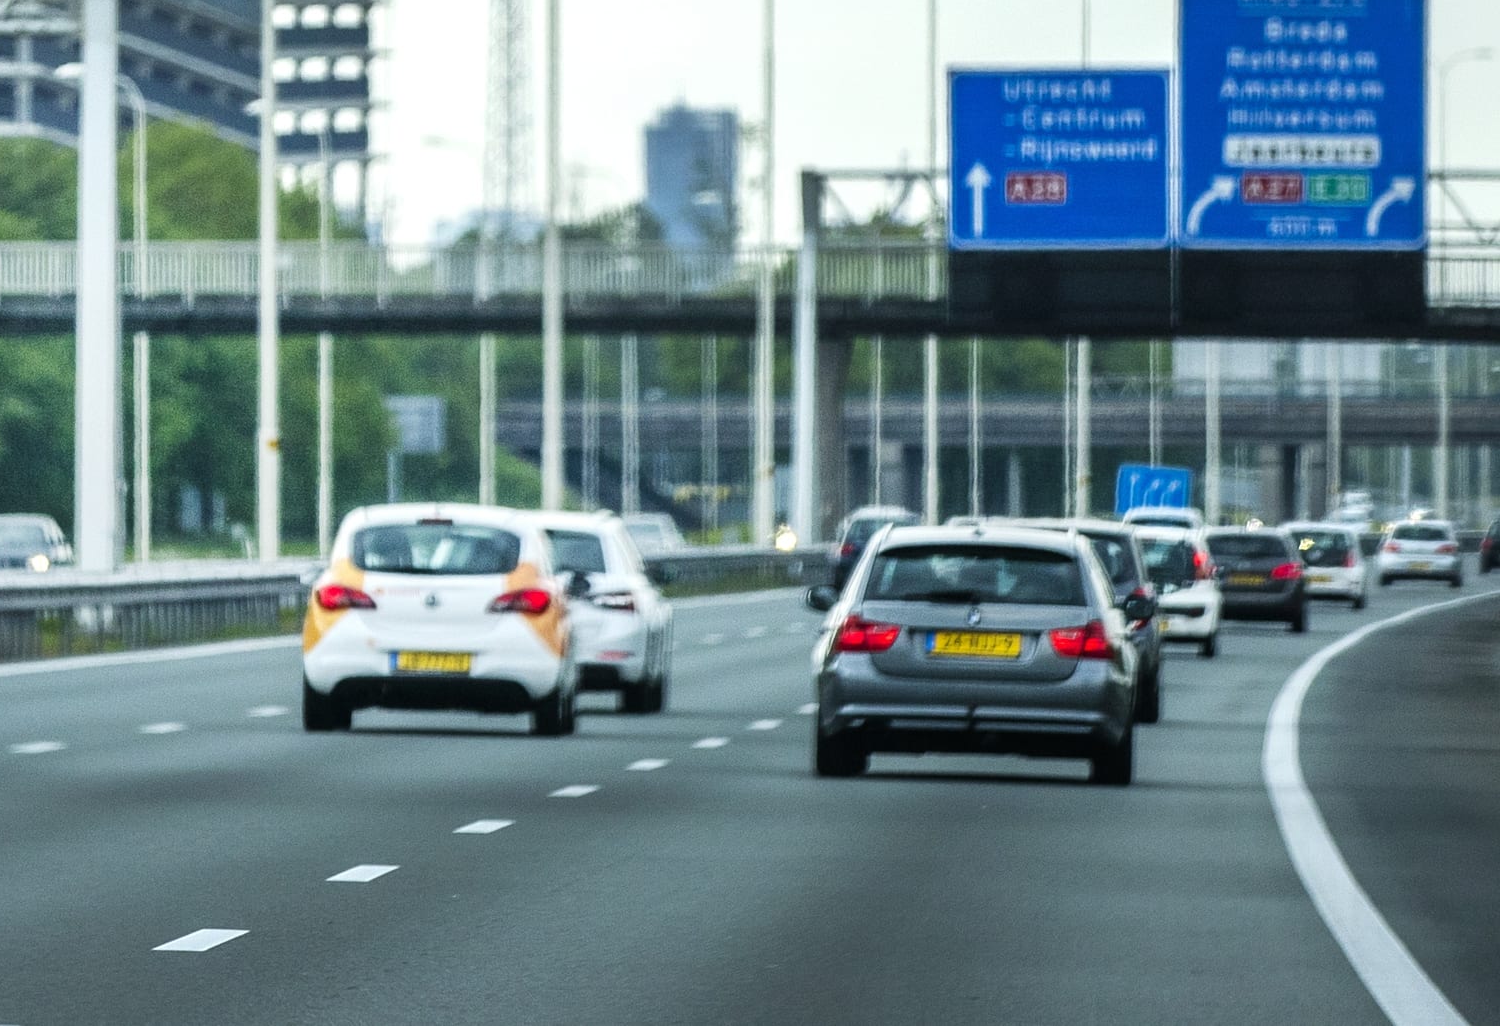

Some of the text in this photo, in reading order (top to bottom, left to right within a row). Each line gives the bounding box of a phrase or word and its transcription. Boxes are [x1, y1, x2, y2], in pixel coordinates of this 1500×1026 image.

[1227, 47, 1377, 71] Rotterdam
[1005, 78, 1111, 102] Utrecht
[1220, 77, 1384, 101] Amsterdam
[1023, 106, 1146, 131] Centrum
